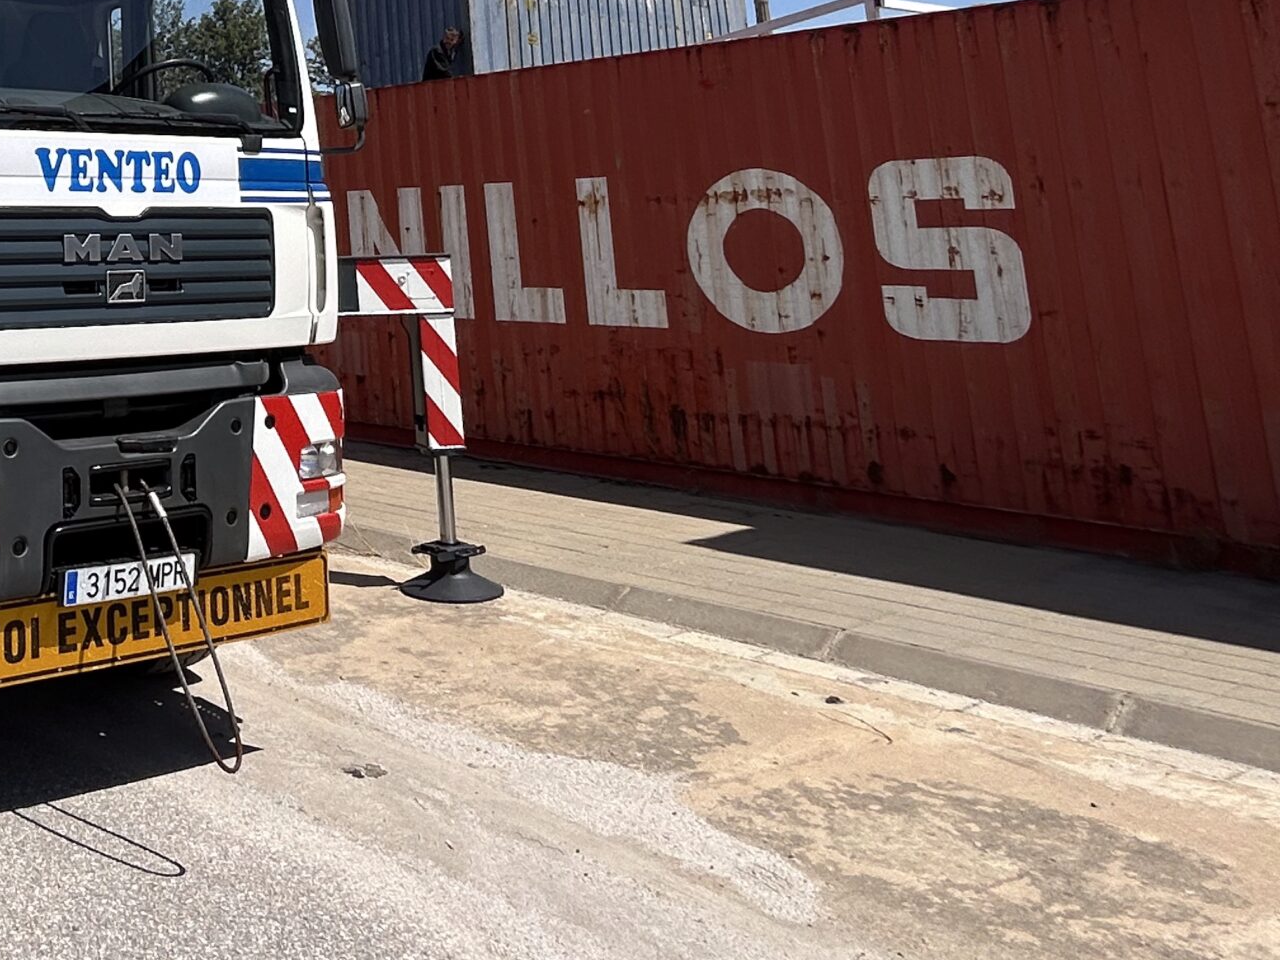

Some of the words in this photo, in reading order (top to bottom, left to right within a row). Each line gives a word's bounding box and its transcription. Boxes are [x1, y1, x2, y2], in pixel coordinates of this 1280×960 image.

[35, 147, 202, 194] VENTEO
[63, 233, 184, 264] MAN
[86, 566, 140, 598] 3152
[148, 560, 186, 589] MPR
[57, 572, 310, 653] EXCEPTIONNEL
